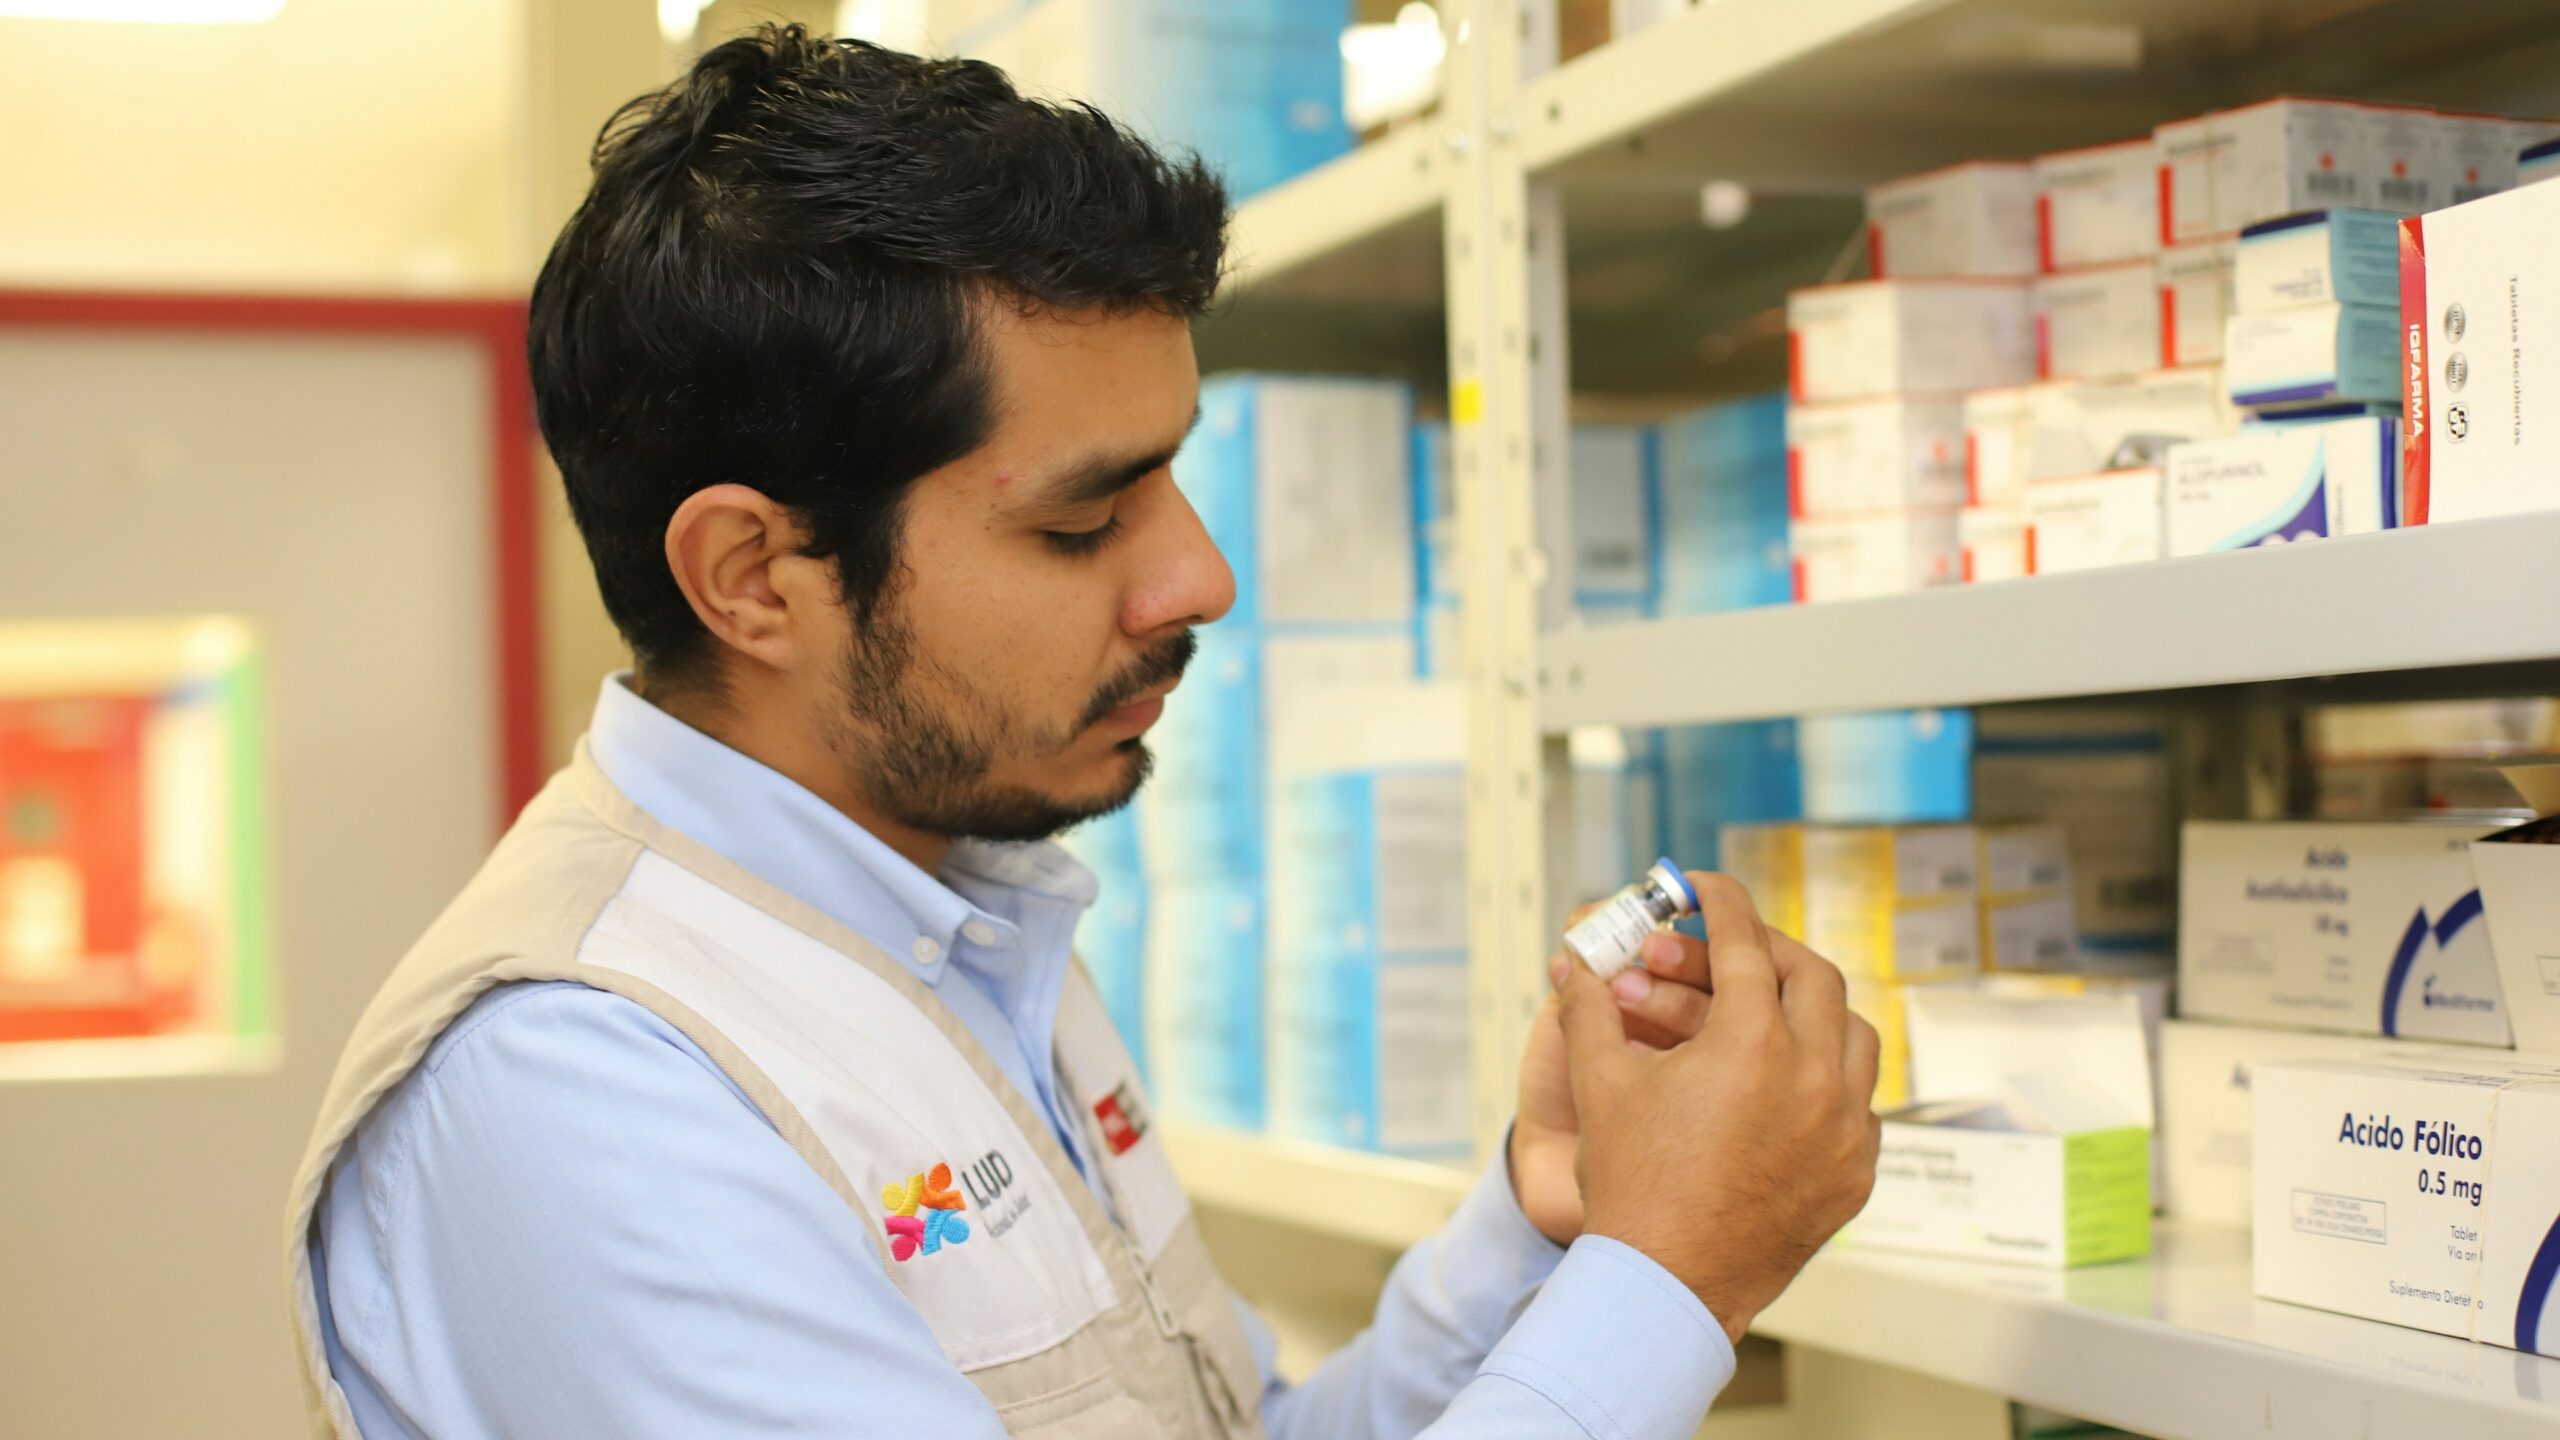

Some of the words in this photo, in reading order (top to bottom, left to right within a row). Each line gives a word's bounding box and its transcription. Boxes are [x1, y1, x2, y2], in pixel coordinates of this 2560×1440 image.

[2509, 273, 2519, 342] Tabletas
[2513, 348, 2521, 445] Recubiertas
[2339, 1112, 2404, 1151] Acido
[2414, 1119, 2483, 1161] Fólico
[2418, 1168, 2447, 1196] 0.5
[2453, 1179, 2483, 1207] mg
[2450, 1224, 2478, 1242] Tablet
[2465, 1248, 2483, 1264] orl
[2389, 1279, 2441, 1302] Suplemento
